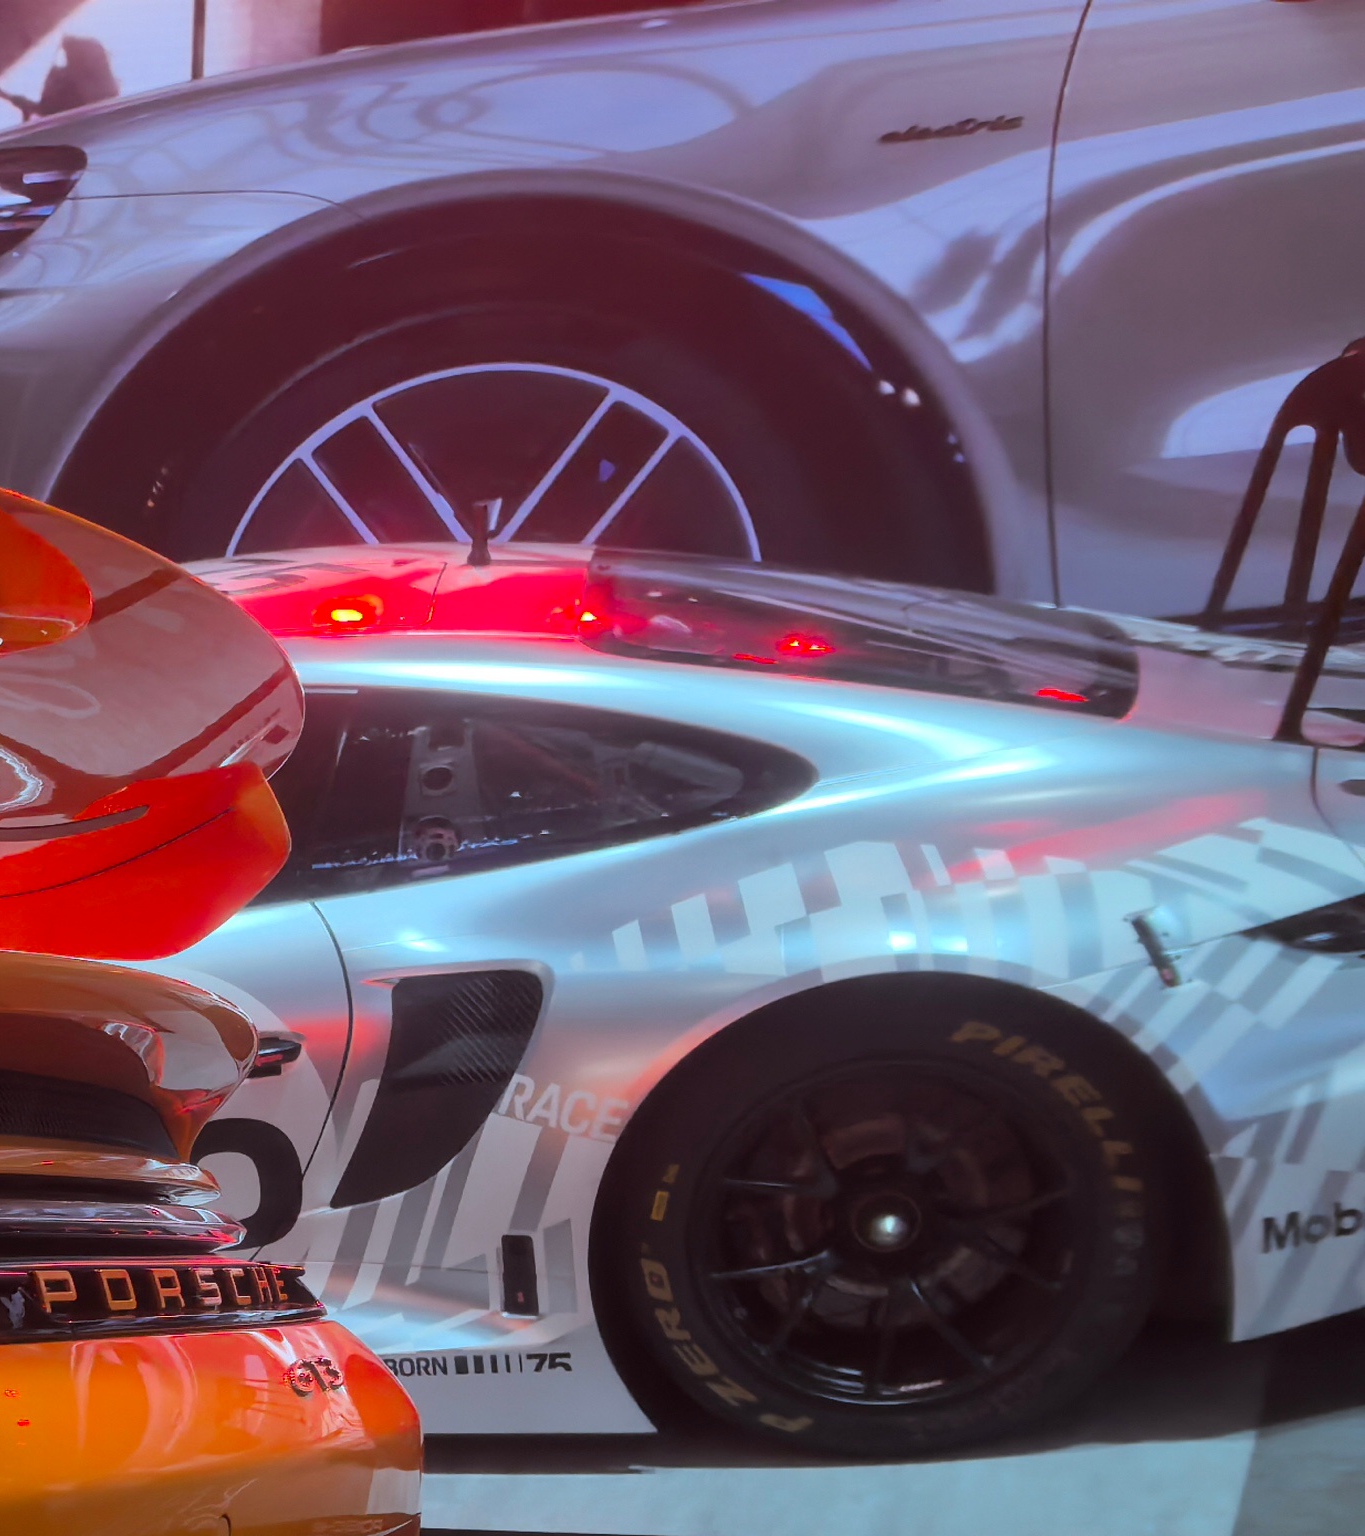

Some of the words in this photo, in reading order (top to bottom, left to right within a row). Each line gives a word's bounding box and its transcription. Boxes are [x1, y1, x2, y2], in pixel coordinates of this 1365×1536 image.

[497, 1072, 629, 1141] RACE
[950, 1020, 1144, 1193] PIRELLI
[32, 1267, 288, 1313] PORSCHE
[640, 1257, 759, 1409] ZERO
